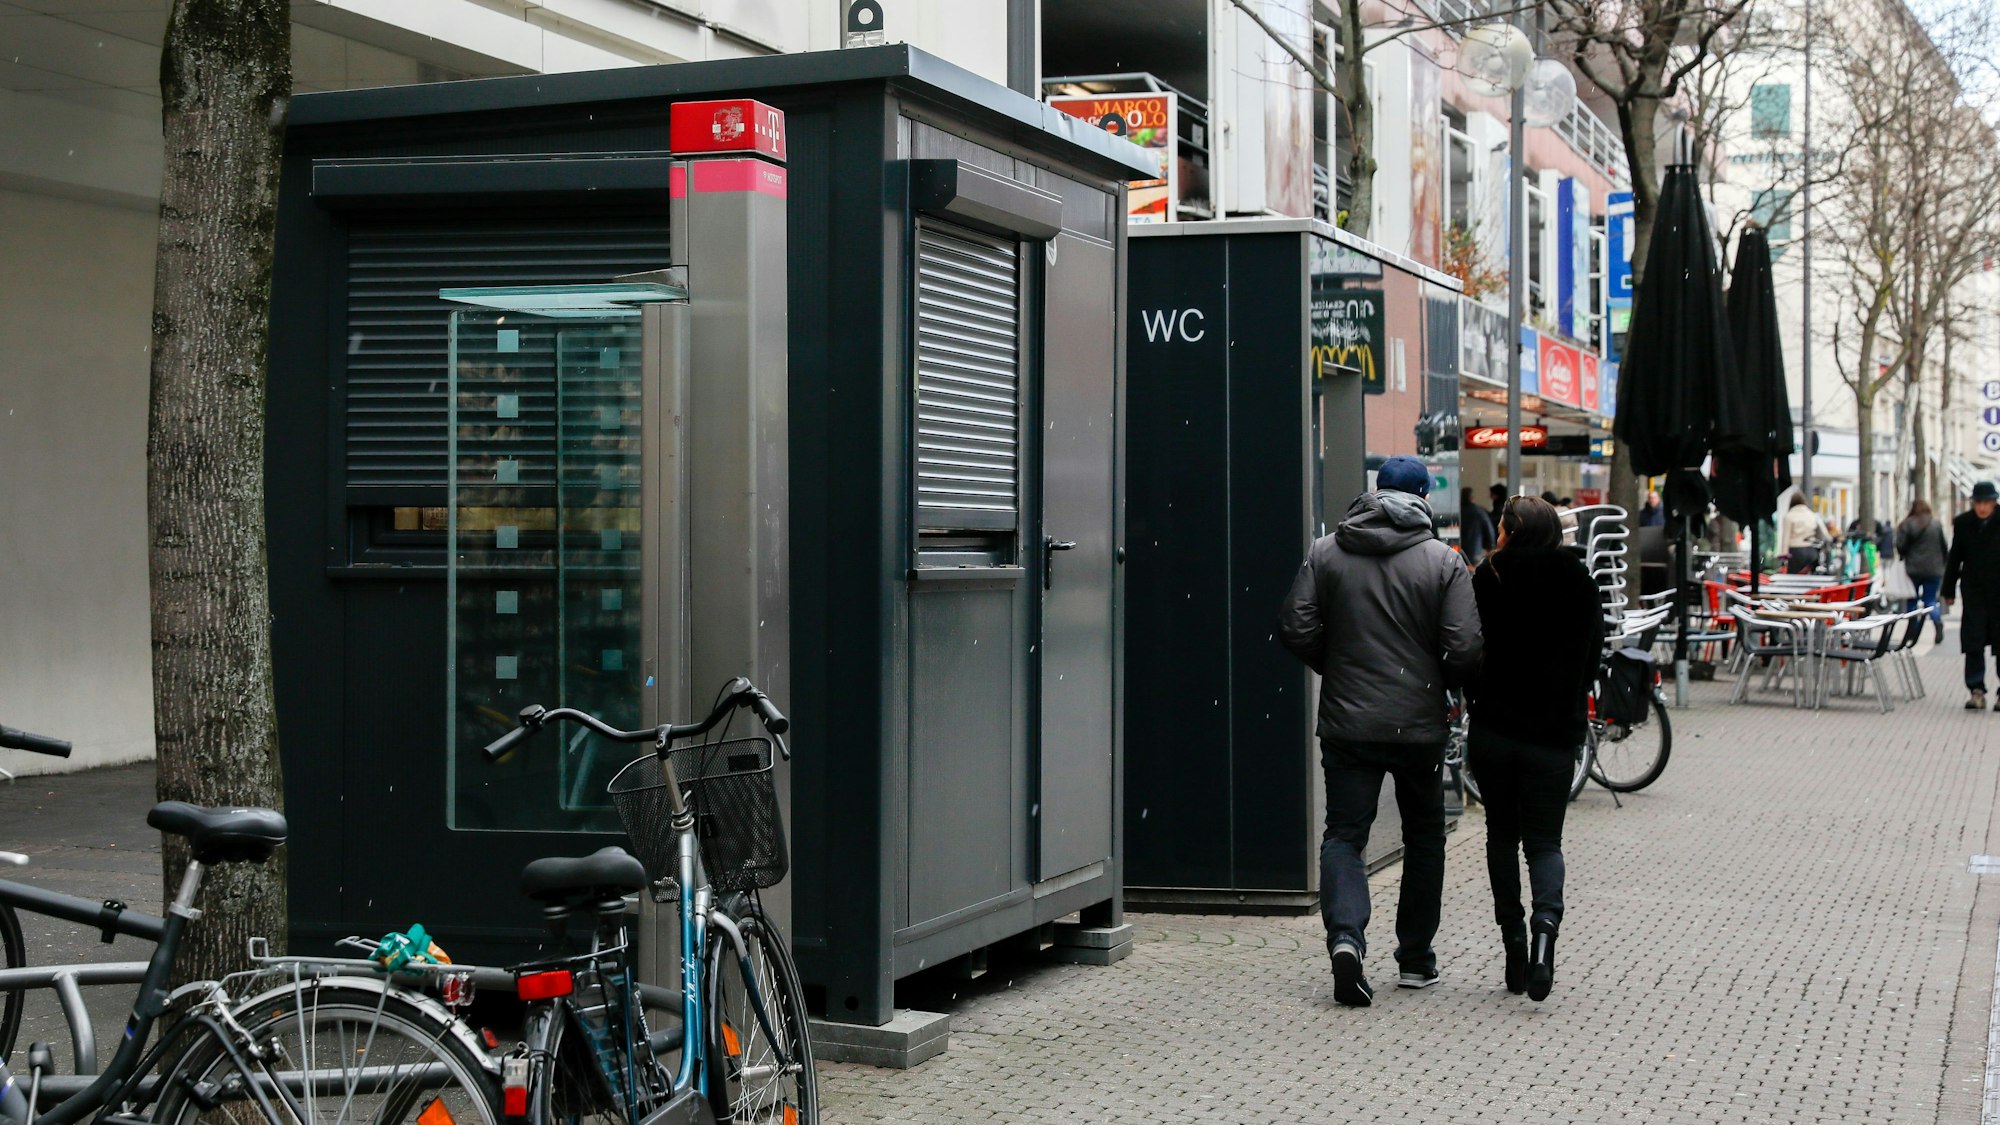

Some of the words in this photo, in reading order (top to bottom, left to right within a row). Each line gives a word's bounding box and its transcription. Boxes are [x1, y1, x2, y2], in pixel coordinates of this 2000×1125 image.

[1093, 99, 1161, 115] MARCO
[1127, 109, 1167, 127] OLO
[1142, 308, 1205, 343] WC
